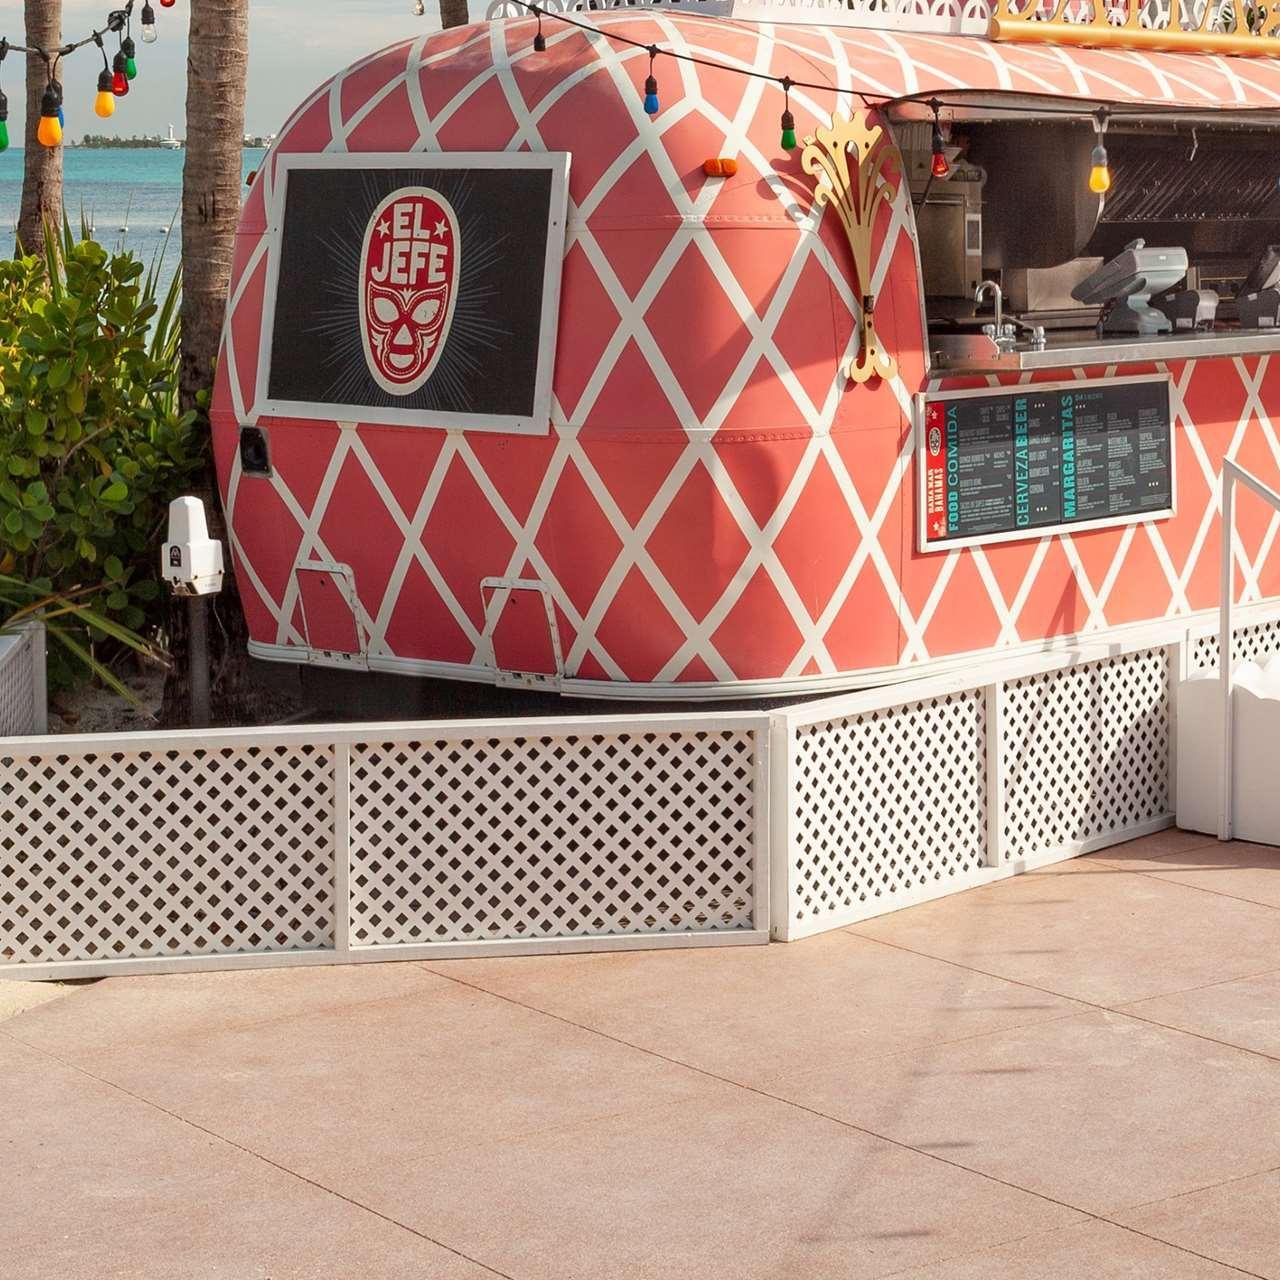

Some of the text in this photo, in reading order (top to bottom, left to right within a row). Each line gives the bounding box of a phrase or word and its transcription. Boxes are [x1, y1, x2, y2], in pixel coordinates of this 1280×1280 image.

[393, 203, 431, 239] EL
[371, 240, 449, 285] JEFE
[947, 406, 959, 532] FOOD COMIDA
[1061, 395, 1076, 518] MARGARITAS
[934, 467, 944, 513] BAHAMAS
[1015, 449, 1030, 526] CERVEZA
